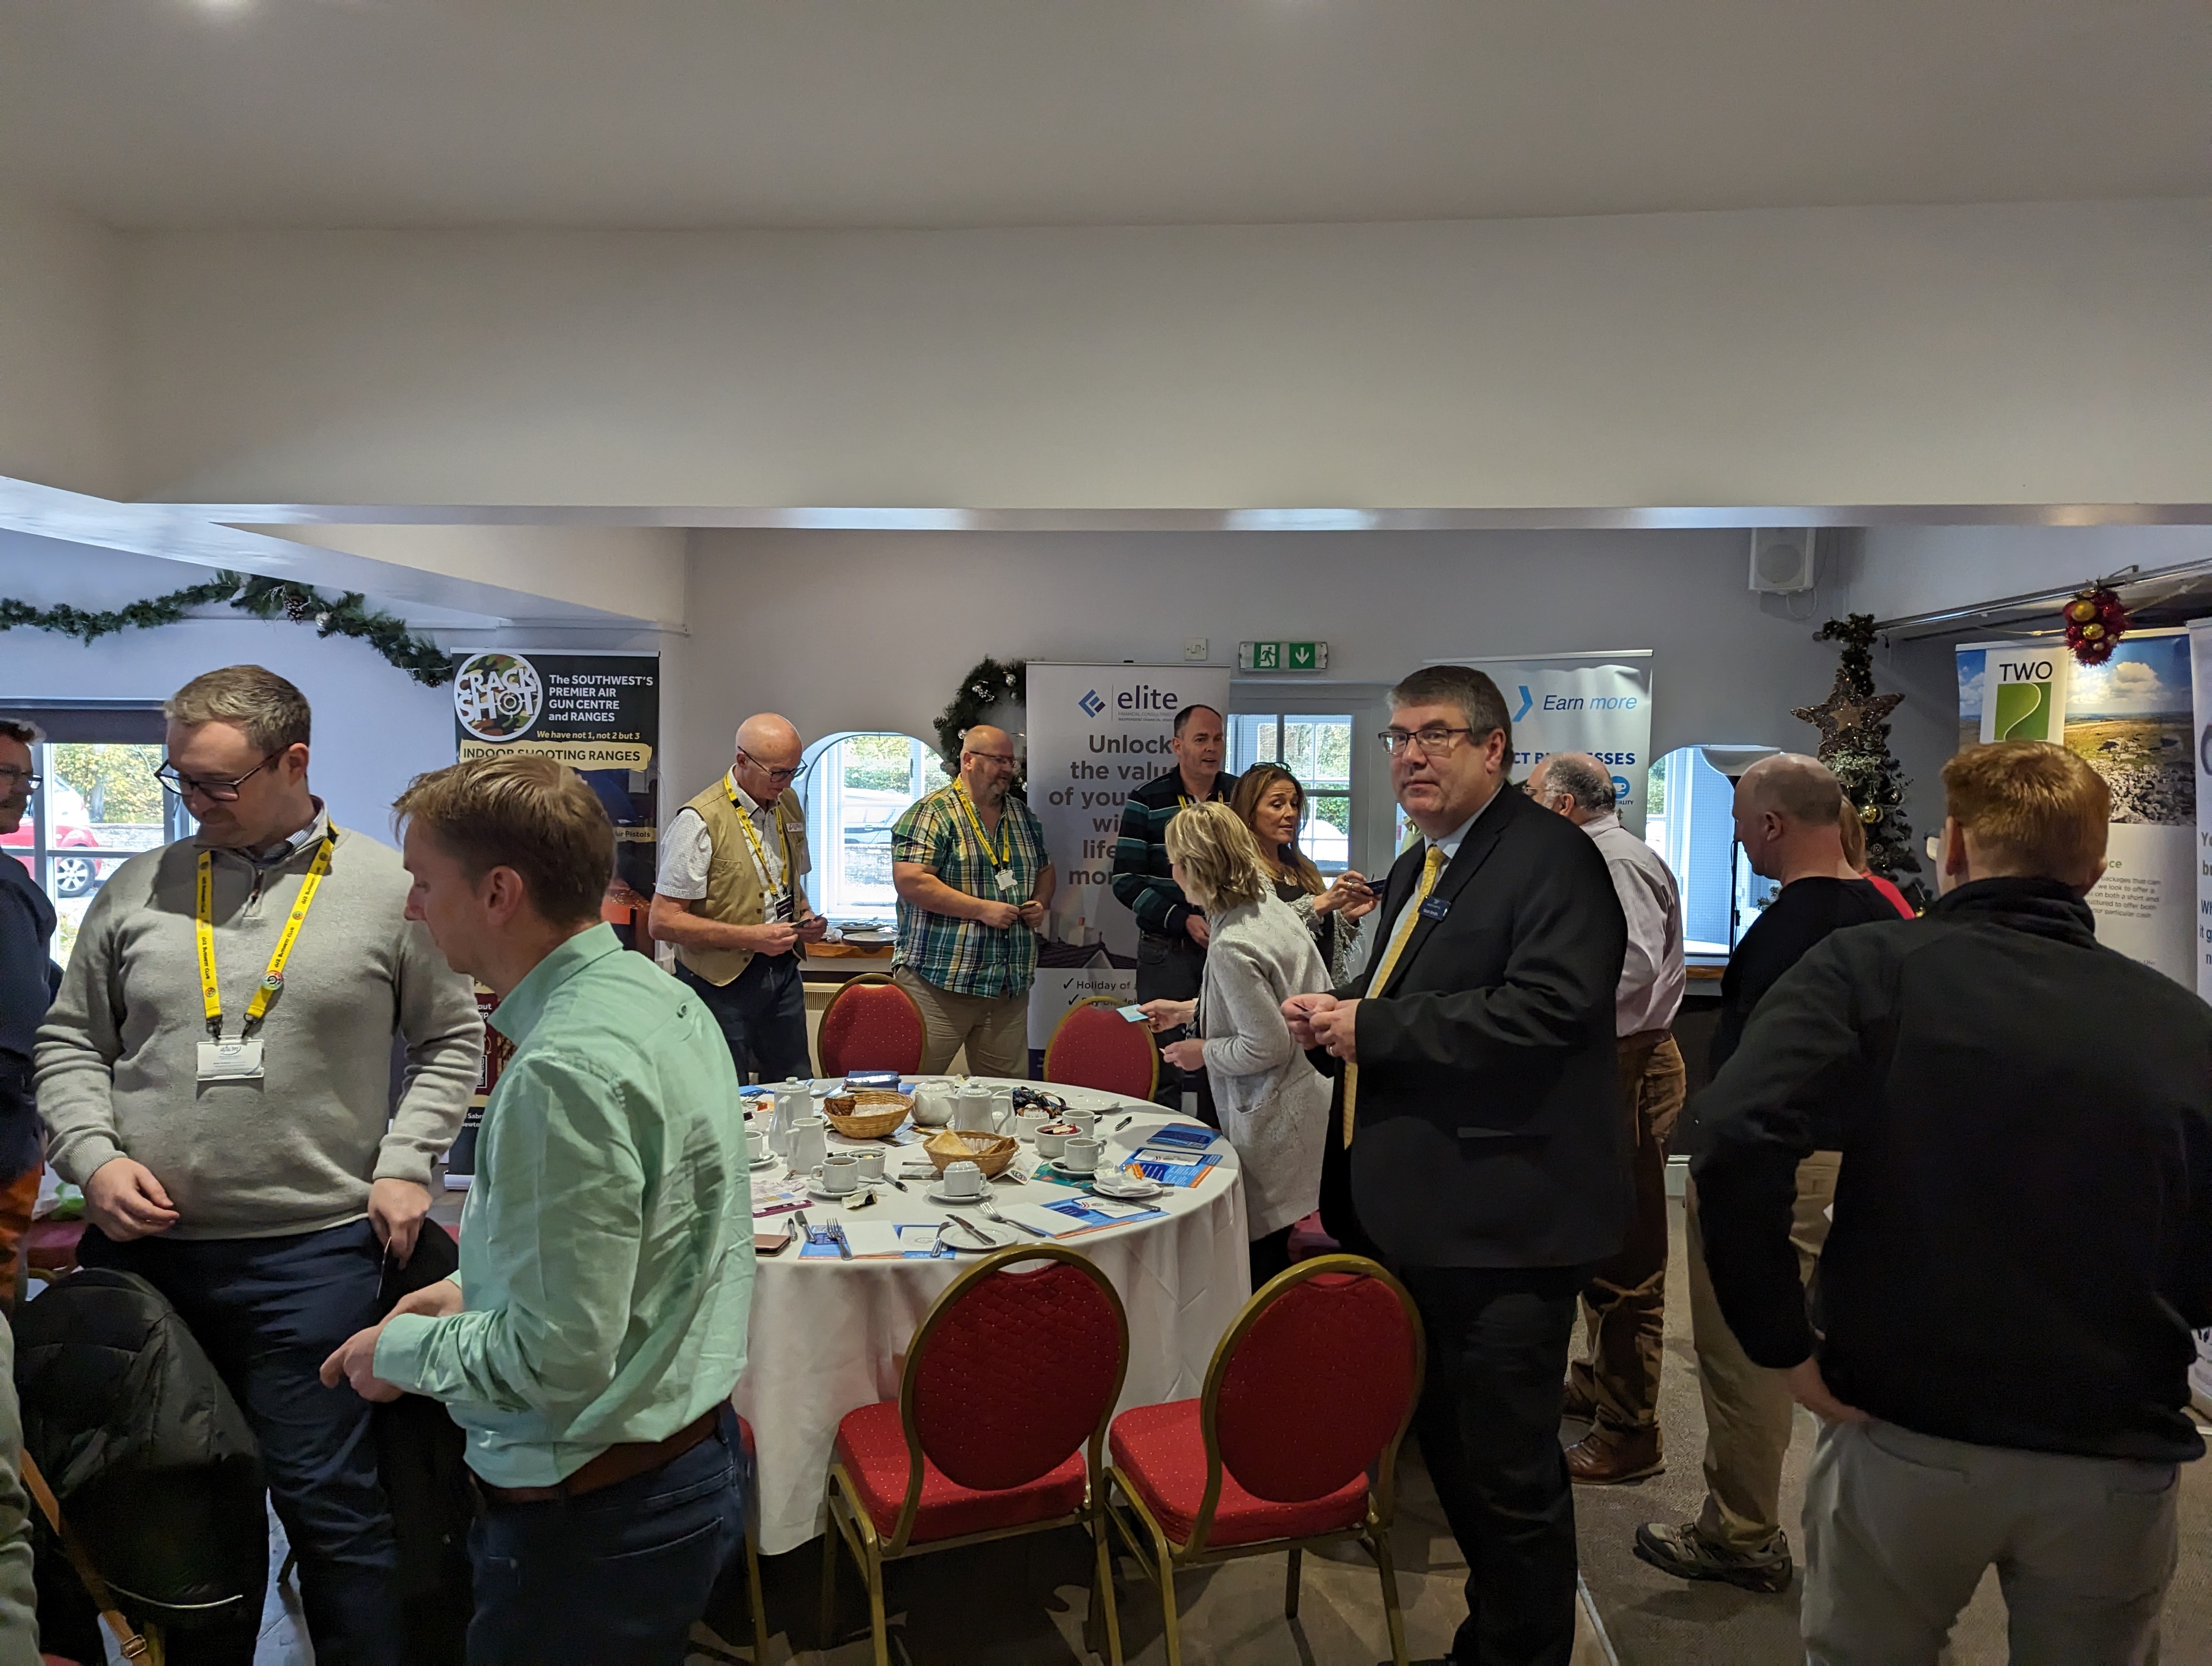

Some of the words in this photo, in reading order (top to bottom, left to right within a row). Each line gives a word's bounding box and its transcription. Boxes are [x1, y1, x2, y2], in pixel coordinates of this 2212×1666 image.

[1999, 661, 2053, 681] TWO
[459, 668, 537, 694] CRACK
[549, 675, 569, 684] The
[571, 675, 653, 686] SOUTHWEST'S
[549, 687, 596, 697] PREMIER
[598, 688, 616, 697] AIR
[1118, 685, 1178, 709] elite
[549, 700, 574, 709] GUN
[576, 700, 620, 709] CENTRE
[1544, 695, 1584, 710] Earn
[1590, 697, 1637, 709] more
[548, 712, 568, 721] and
[571, 713, 615, 722] RANGES
[1089, 734, 1172, 754] Unlock
[589, 751, 640, 761] RANGES
[1070, 760, 1109, 780] the
[1117, 761, 1174, 780] valu
[1049, 786, 1073, 805] of
[1077, 981, 1116, 991] Holiday
